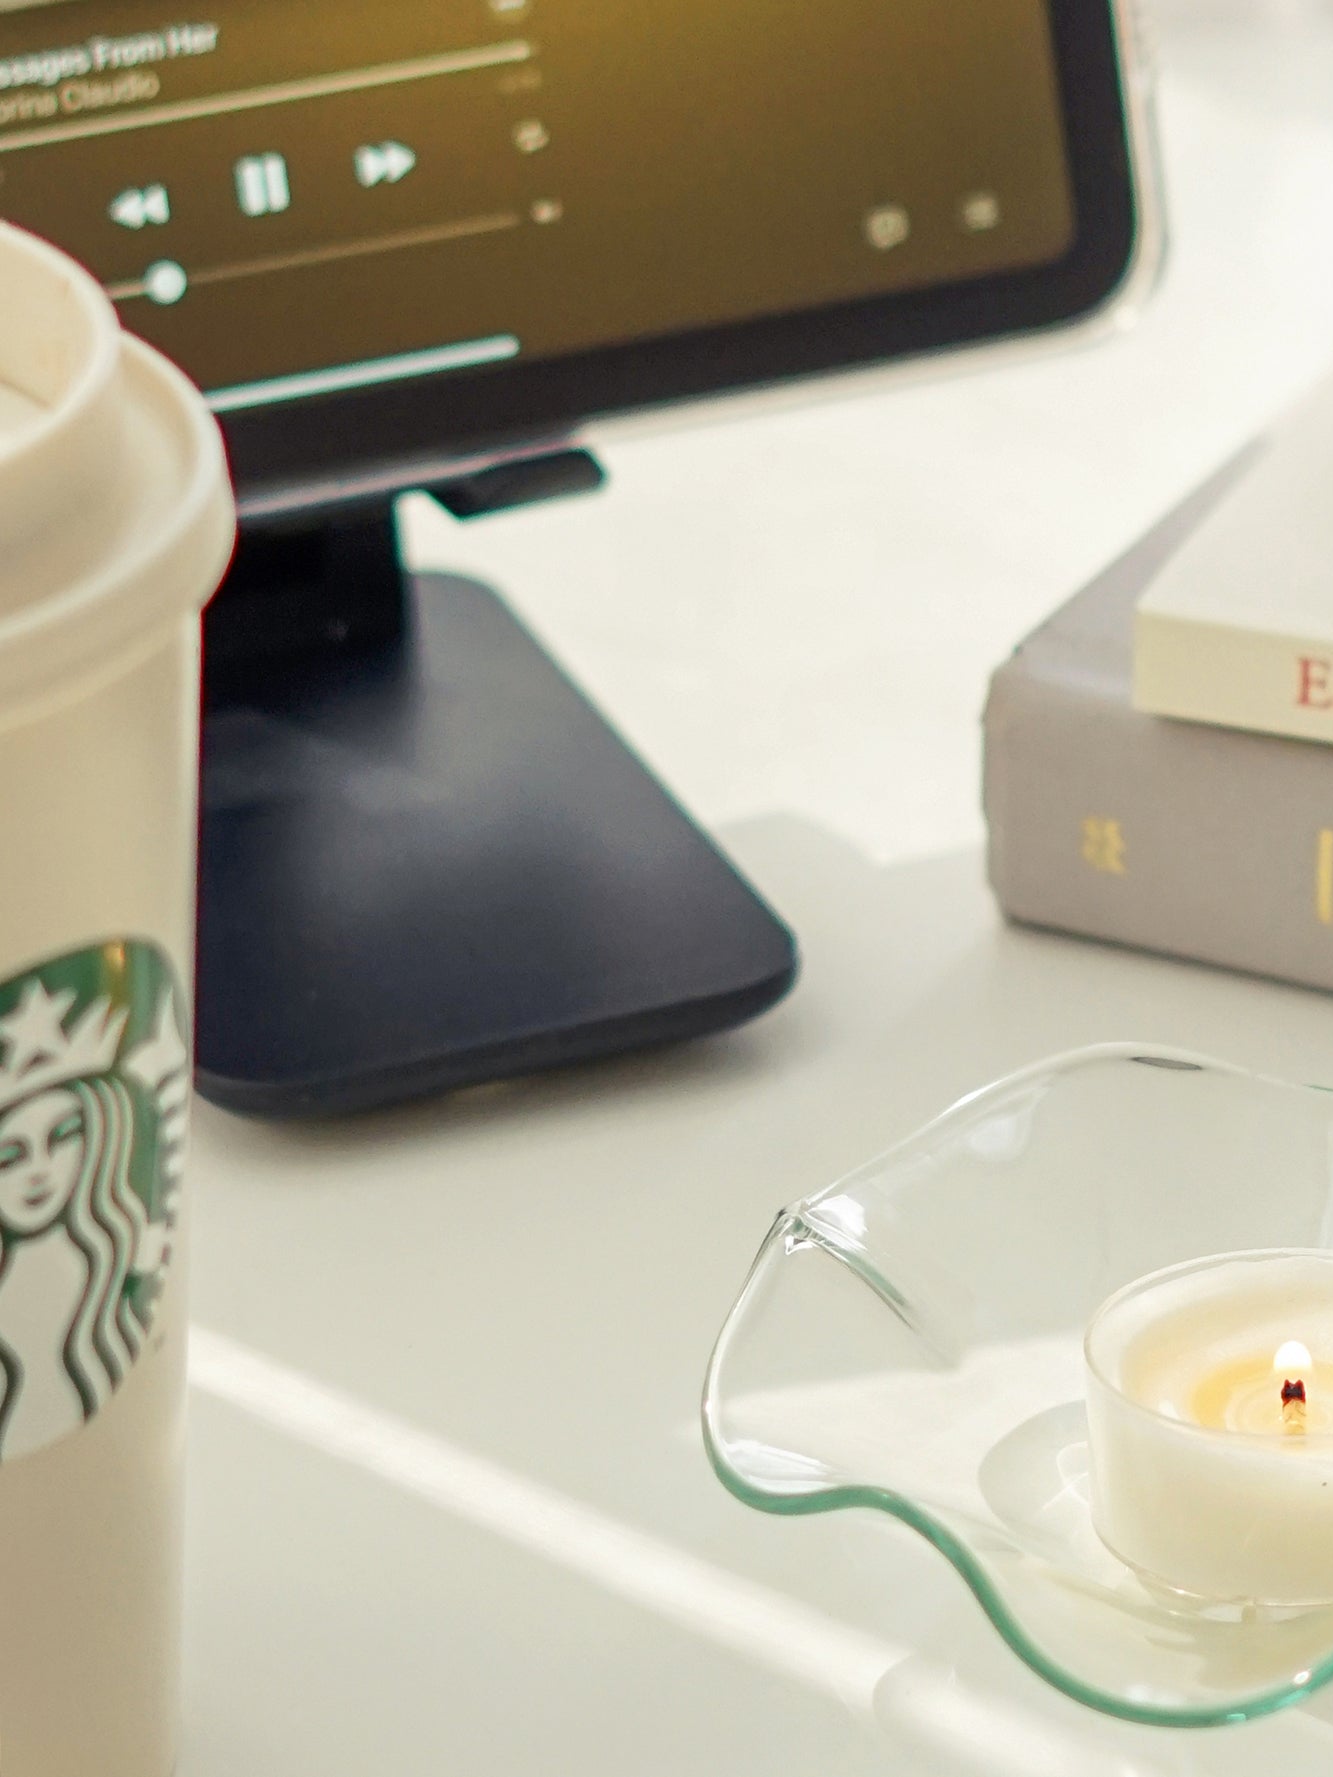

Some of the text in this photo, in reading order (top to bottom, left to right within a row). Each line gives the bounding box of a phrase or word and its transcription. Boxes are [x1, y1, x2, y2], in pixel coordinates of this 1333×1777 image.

[88, 33, 166, 71] From
[165, 22, 219, 58] Her
[57, 69, 161, 115] Claudio
